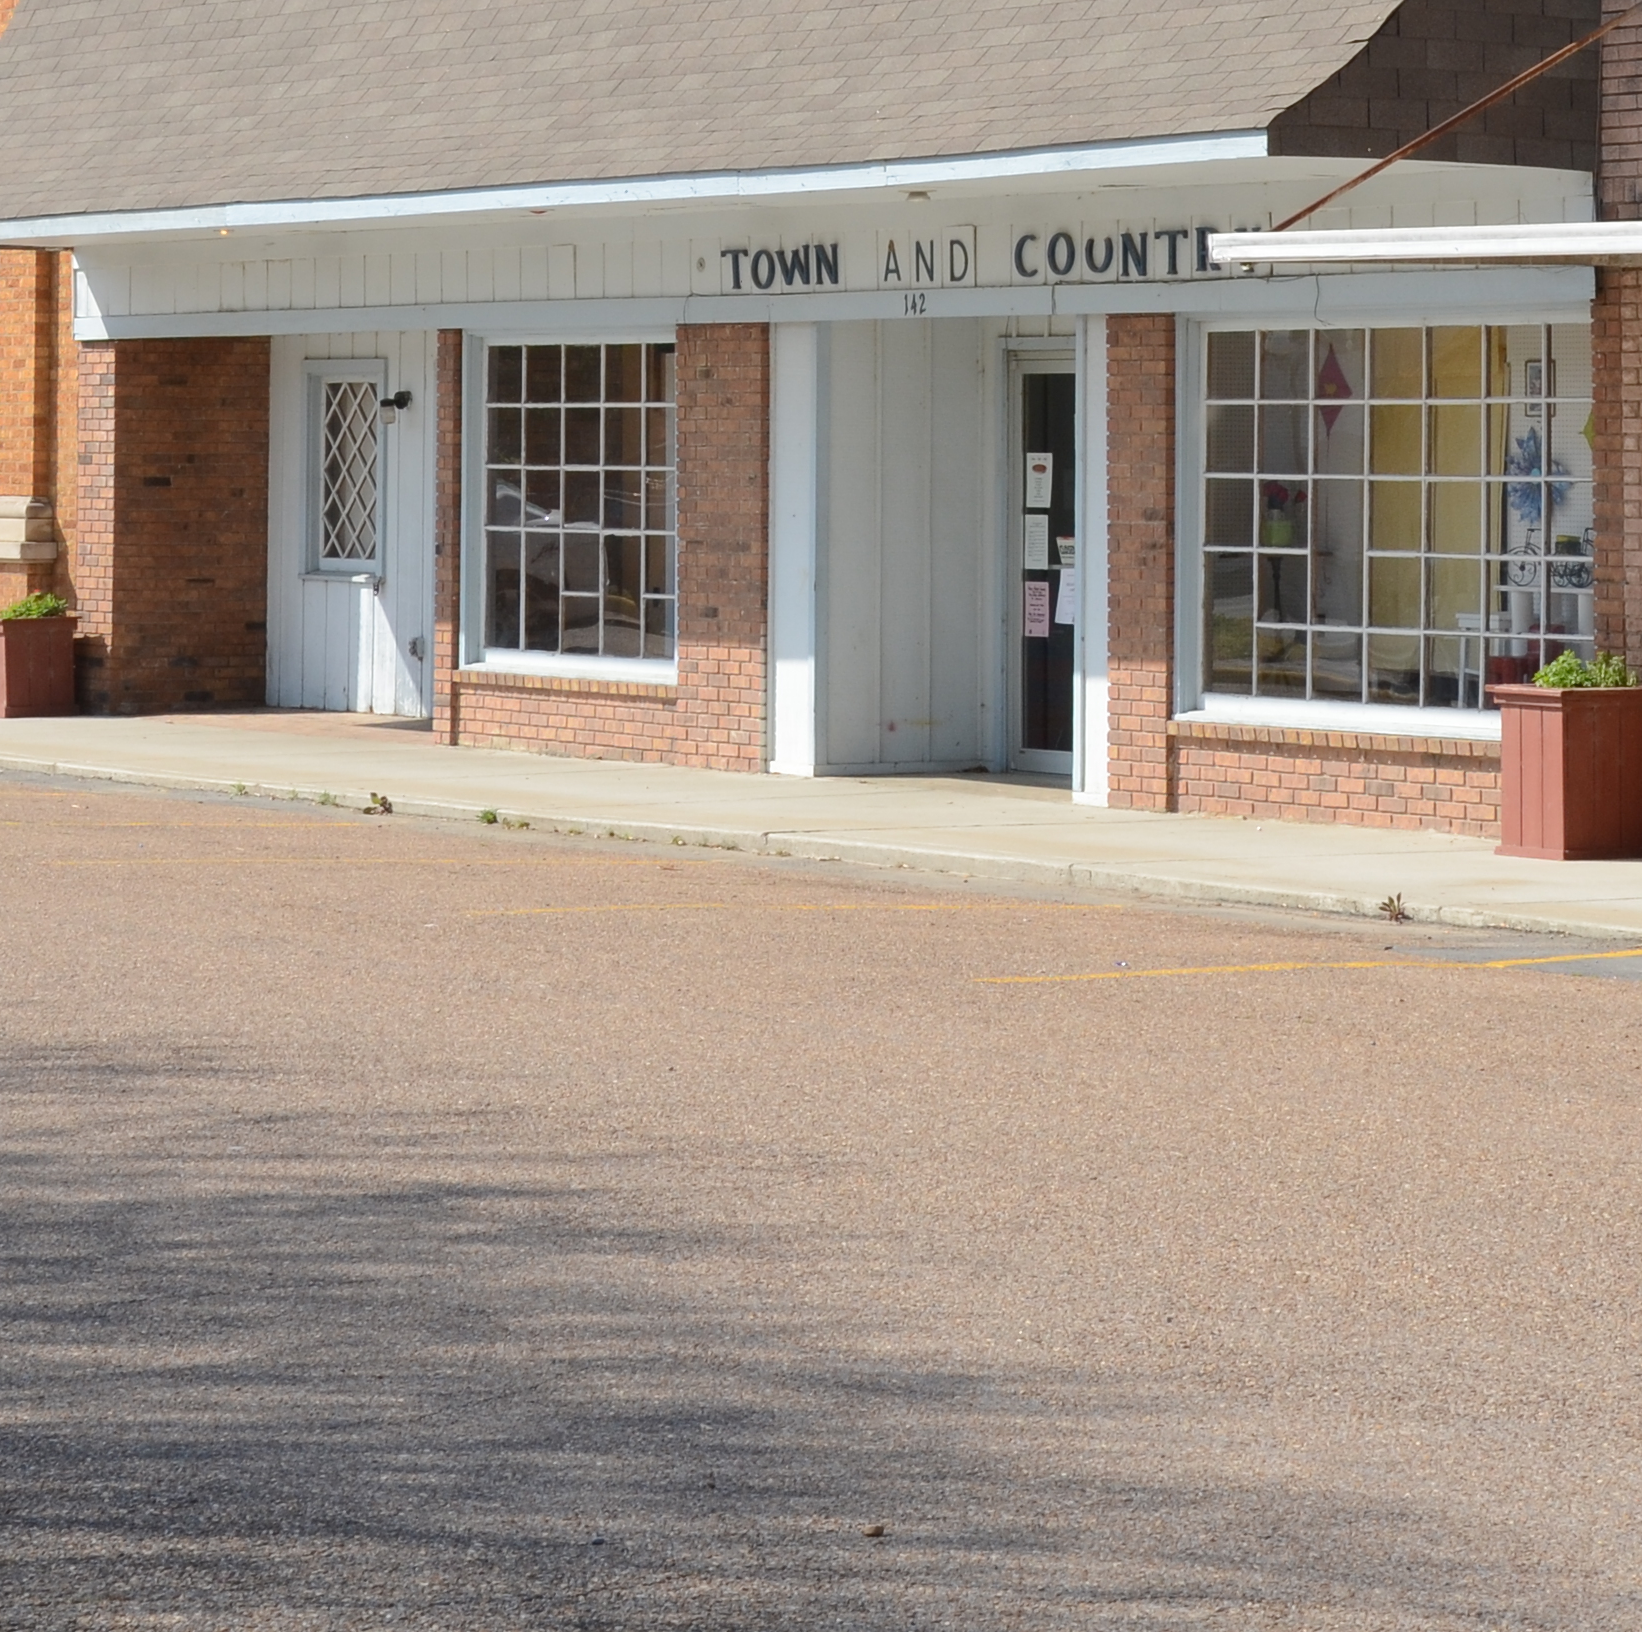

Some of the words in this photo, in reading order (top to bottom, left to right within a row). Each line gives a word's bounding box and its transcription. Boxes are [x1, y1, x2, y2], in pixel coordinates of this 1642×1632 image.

[720, 242, 840, 290] TOWN
[883, 239, 969, 283] AND
[1013, 226, 1262, 278] COUNTR
[903, 292, 927, 316] 142
